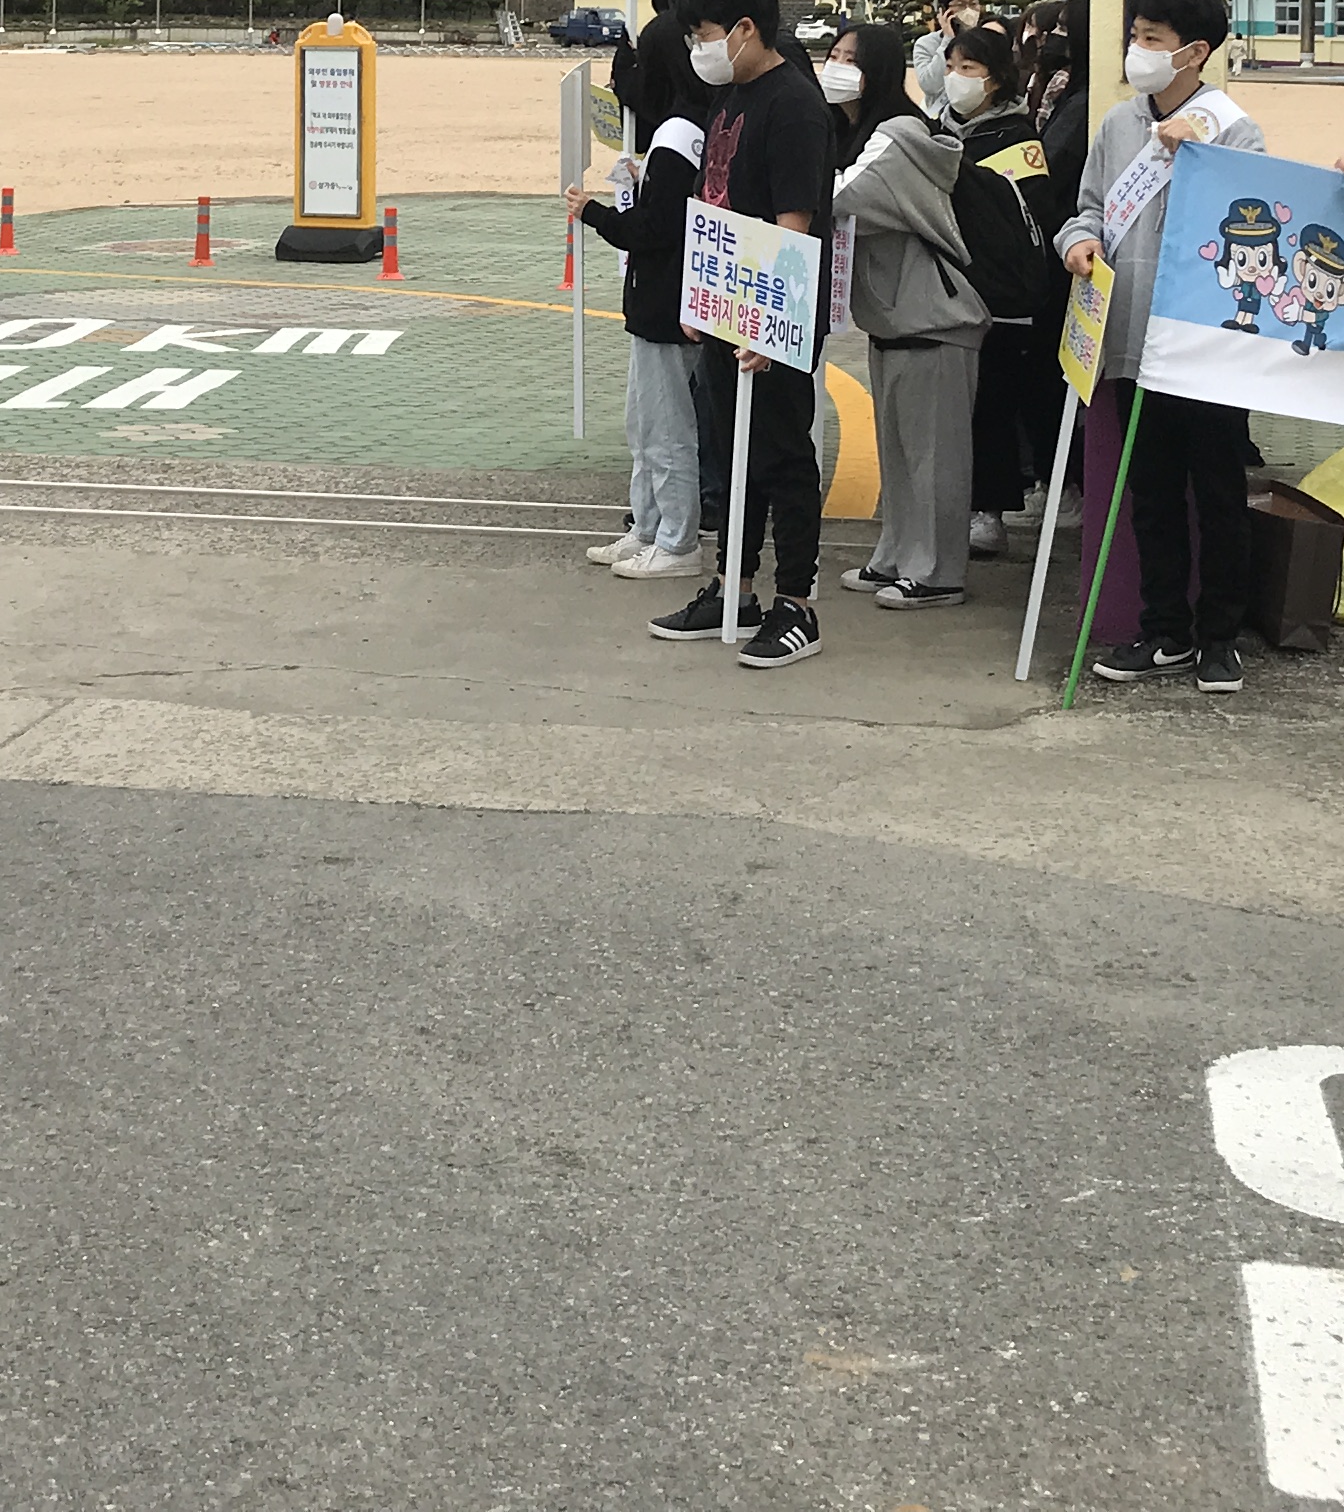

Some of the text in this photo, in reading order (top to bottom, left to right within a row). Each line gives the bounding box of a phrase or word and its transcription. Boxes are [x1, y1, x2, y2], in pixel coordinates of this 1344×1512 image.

[692, 214, 737, 256] 우리는
[691, 250, 786, 312] 다른 친구들을
[688, 286, 803, 357] 괴롭히지 않을 것이다
